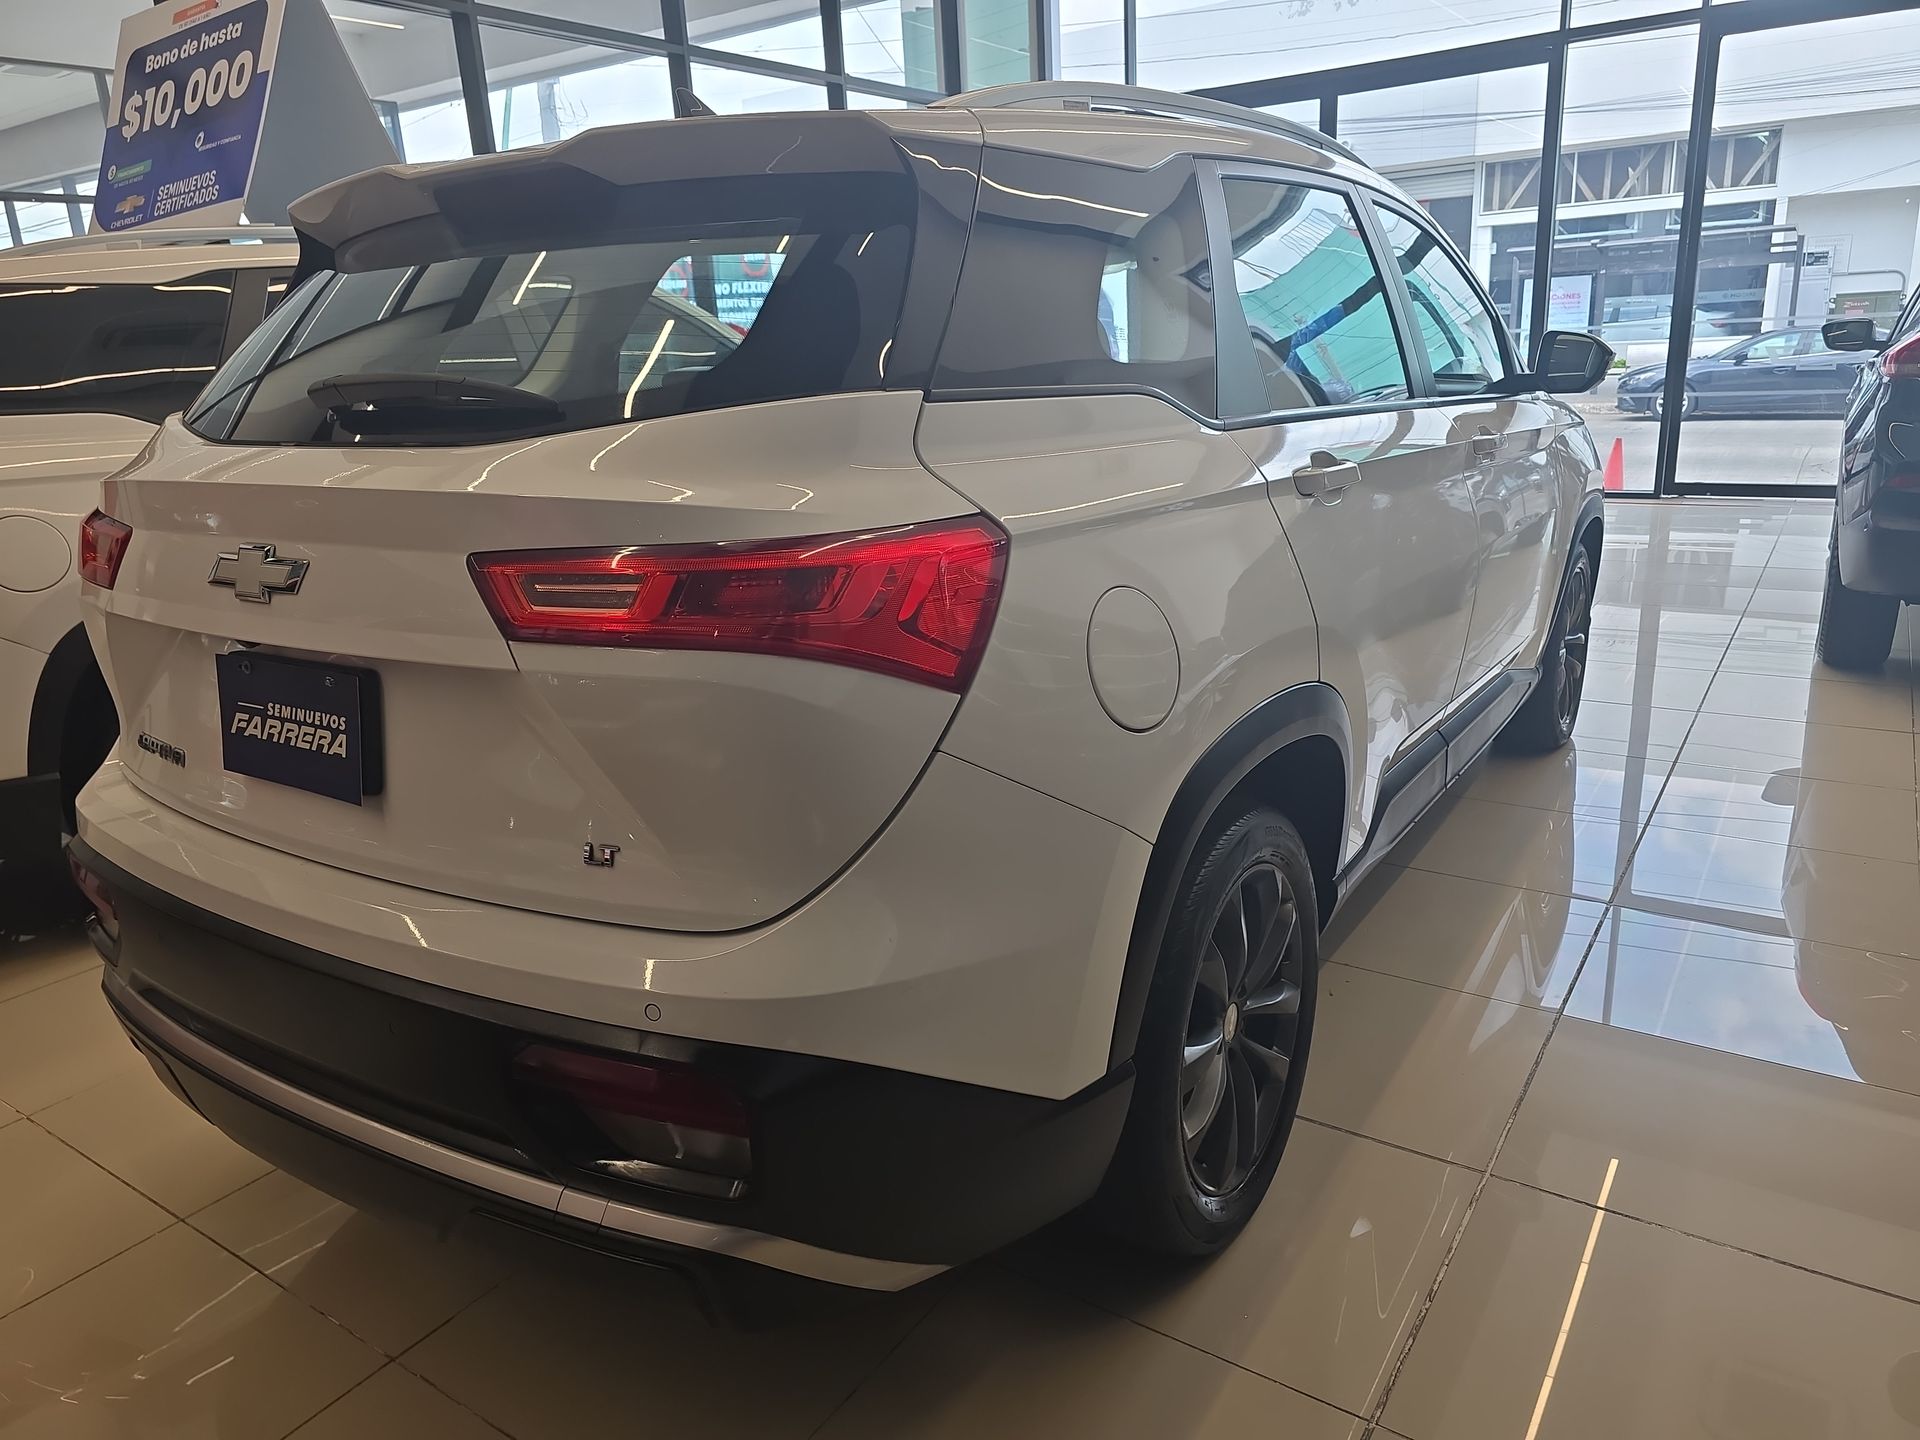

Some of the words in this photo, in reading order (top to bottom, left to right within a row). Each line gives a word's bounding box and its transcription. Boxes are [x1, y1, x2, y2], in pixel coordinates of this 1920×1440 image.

[144, 51, 179, 75] Bono
[180, 38, 197, 59] de
[199, 20, 242, 53] hasta
[121, 49, 253, 142] $10,000
[153, 184, 219, 217] CERTIFICADOS
[157, 169, 217, 201] SEMINUEVOS
[110, 213, 144, 229] CHEVROLET
[266, 702, 347, 731] SEMINUEVOS
[230, 712, 348, 758] FARRERA
[583, 841, 621, 868] LT
